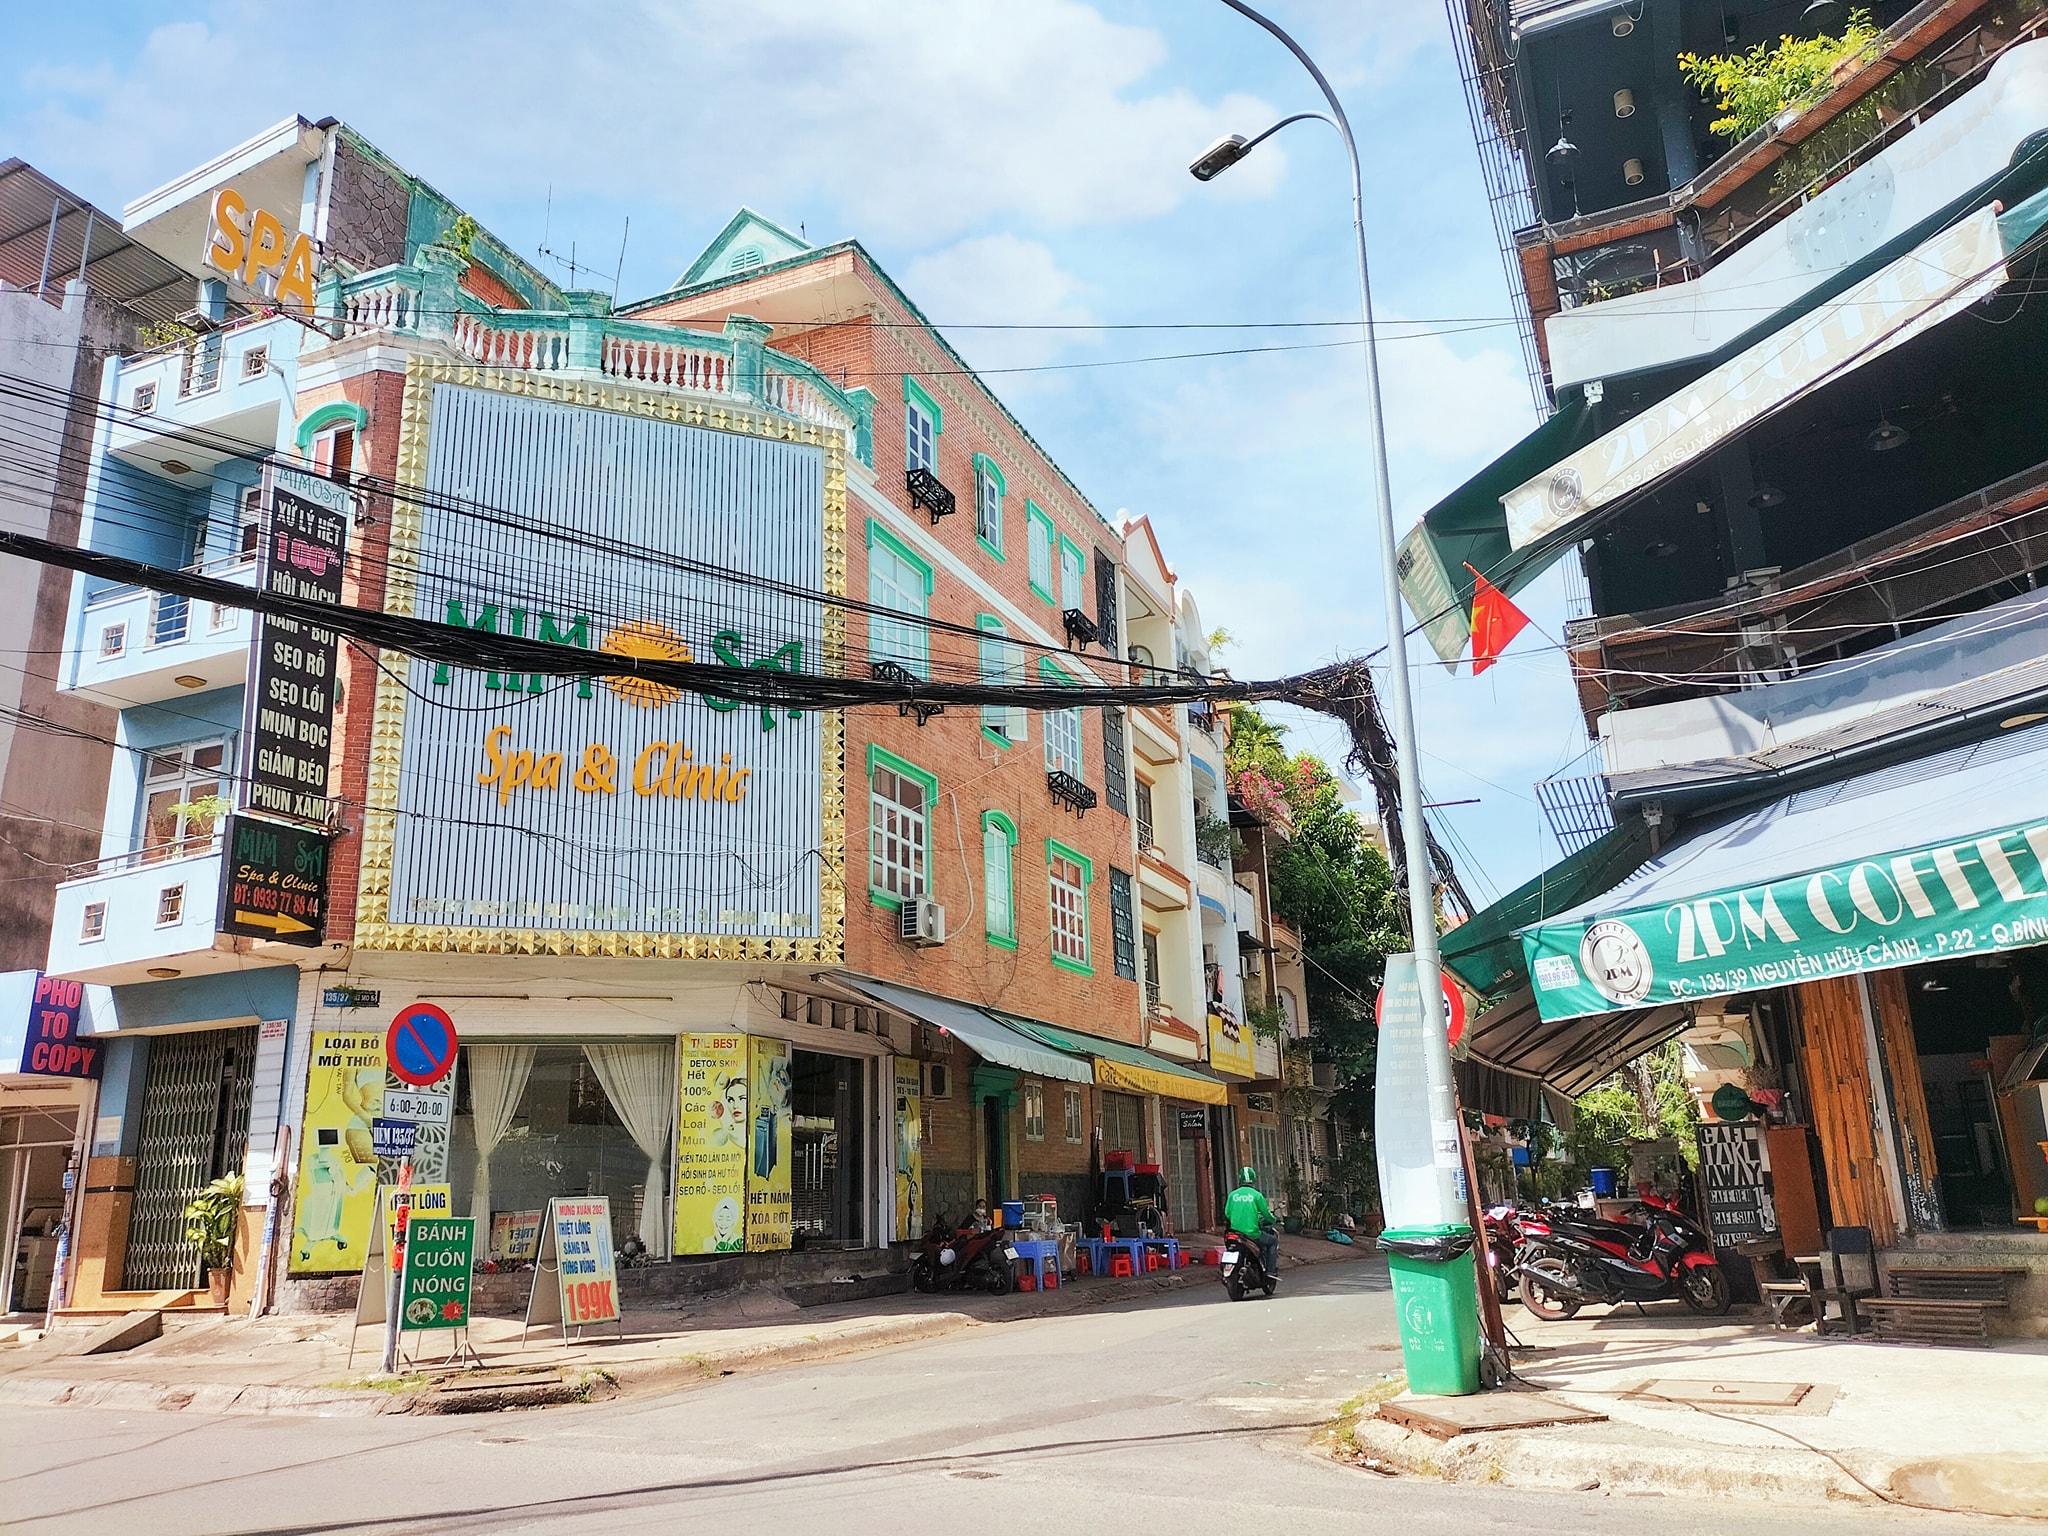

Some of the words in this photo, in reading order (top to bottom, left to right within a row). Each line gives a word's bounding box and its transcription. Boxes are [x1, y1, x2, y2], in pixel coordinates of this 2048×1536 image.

[210, 189, 314, 315] SPA
[1602, 391, 1711, 477] 2PM
[1620, 459, 1660, 490] 135/39
[278, 467, 346, 511] MIMOSA
[277, 498, 298, 528] XỬ
[298, 508, 315, 535] LÝ
[317, 516, 342, 546] HẾT
[272, 570, 297, 596] HÔI
[273, 642, 303, 671] SẸO
[306, 649, 327, 678] RỖ
[269, 676, 299, 707] SẸO
[301, 683, 325, 714] LỒI
[260, 708, 296, 740] MỤN
[298, 719, 328, 749] BỌC
[258, 746, 294, 779] GIẢM
[297, 755, 324, 787] BÉO
[477, 725, 563, 807] Spa
[574, 743, 616, 794] &
[633, 740, 751, 802] Clinic
[252, 783, 292, 814] PHUN
[237, 865, 265, 883] Spa
[268, 870, 280, 885] &
[281, 873, 319, 893] Clinic
[233, 882, 251, 905] ĐT:
[253, 886, 278, 911] 0933
[280, 891, 293, 913] 77
[293, 894, 306, 916] 88
[307, 897, 319, 918] 44
[1664, 883, 1801, 964] 2PM
[1668, 978, 1697, 997] ĐC:
[1699, 967, 1748, 992] 135/39
[1748, 949, 1824, 984] NGUYỄN
[1823, 945, 1863, 970] HỮU
[1866, 934, 1921, 964] CẢNH
[1934, 927, 1976, 953] P.22
[1603, 965, 1633, 981] 2PM
[35, 977, 82, 1008] PHO
[41, 1010, 69, 1039] TO
[324, 1038, 355, 1051] LOẠI
[361, 1035, 379, 1049] BỎ
[713, 1038, 739, 1049] BEST
[32, 1042, 97, 1075] COPY
[318, 1055, 343, 1067] MỠ
[346, 1054, 381, 1067] THỪA
[690, 1060, 717, 1068] DETOX
[719, 1059, 738, 1067] SKIN
[687, 1069, 706, 1080] Hết
[683, 1086, 712, 1096] 100%
[390, 1099, 443, 1116] 6:00-20:00
[685, 1103, 706, 1113] Các
[392, 1127, 416, 1146] 135/37
[680, 1151, 694, 1163] KIẾN
[721, 1153, 730, 1162] DA
[692, 1169, 707, 1179] SINH
[707, 1169, 716, 1179] DA
[1705, 1163, 1764, 1187] AWAY
[419, 1190, 446, 1210] LÔNG
[750, 1188, 768, 1204] HẾT
[770, 1190, 790, 1204] NÁM
[1232, 1193, 1255, 1203] Grab
[1709, 1189, 1732, 1203] CAFE
[751, 1211, 770, 1225] XÓA
[772, 1210, 789, 1224] BỚT
[1712, 1211, 1736, 1225] CAFE
[417, 1222, 467, 1241] BÁNH
[558, 1219, 574, 1238] TRIỆT
[574, 1219, 591, 1235] LÔNG
[563, 1239, 581, 1255] SÁNG
[580, 1241, 591, 1254] DA
[751, 1232, 770, 1248] TẬN
[414, 1246, 466, 1268] CUỐN
[562, 1258, 578, 1275] TỪNG
[579, 1257, 596, 1274] VÙNG
[412, 1273, 465, 1294] NÓNG
[565, 1280, 616, 1322] 199K
